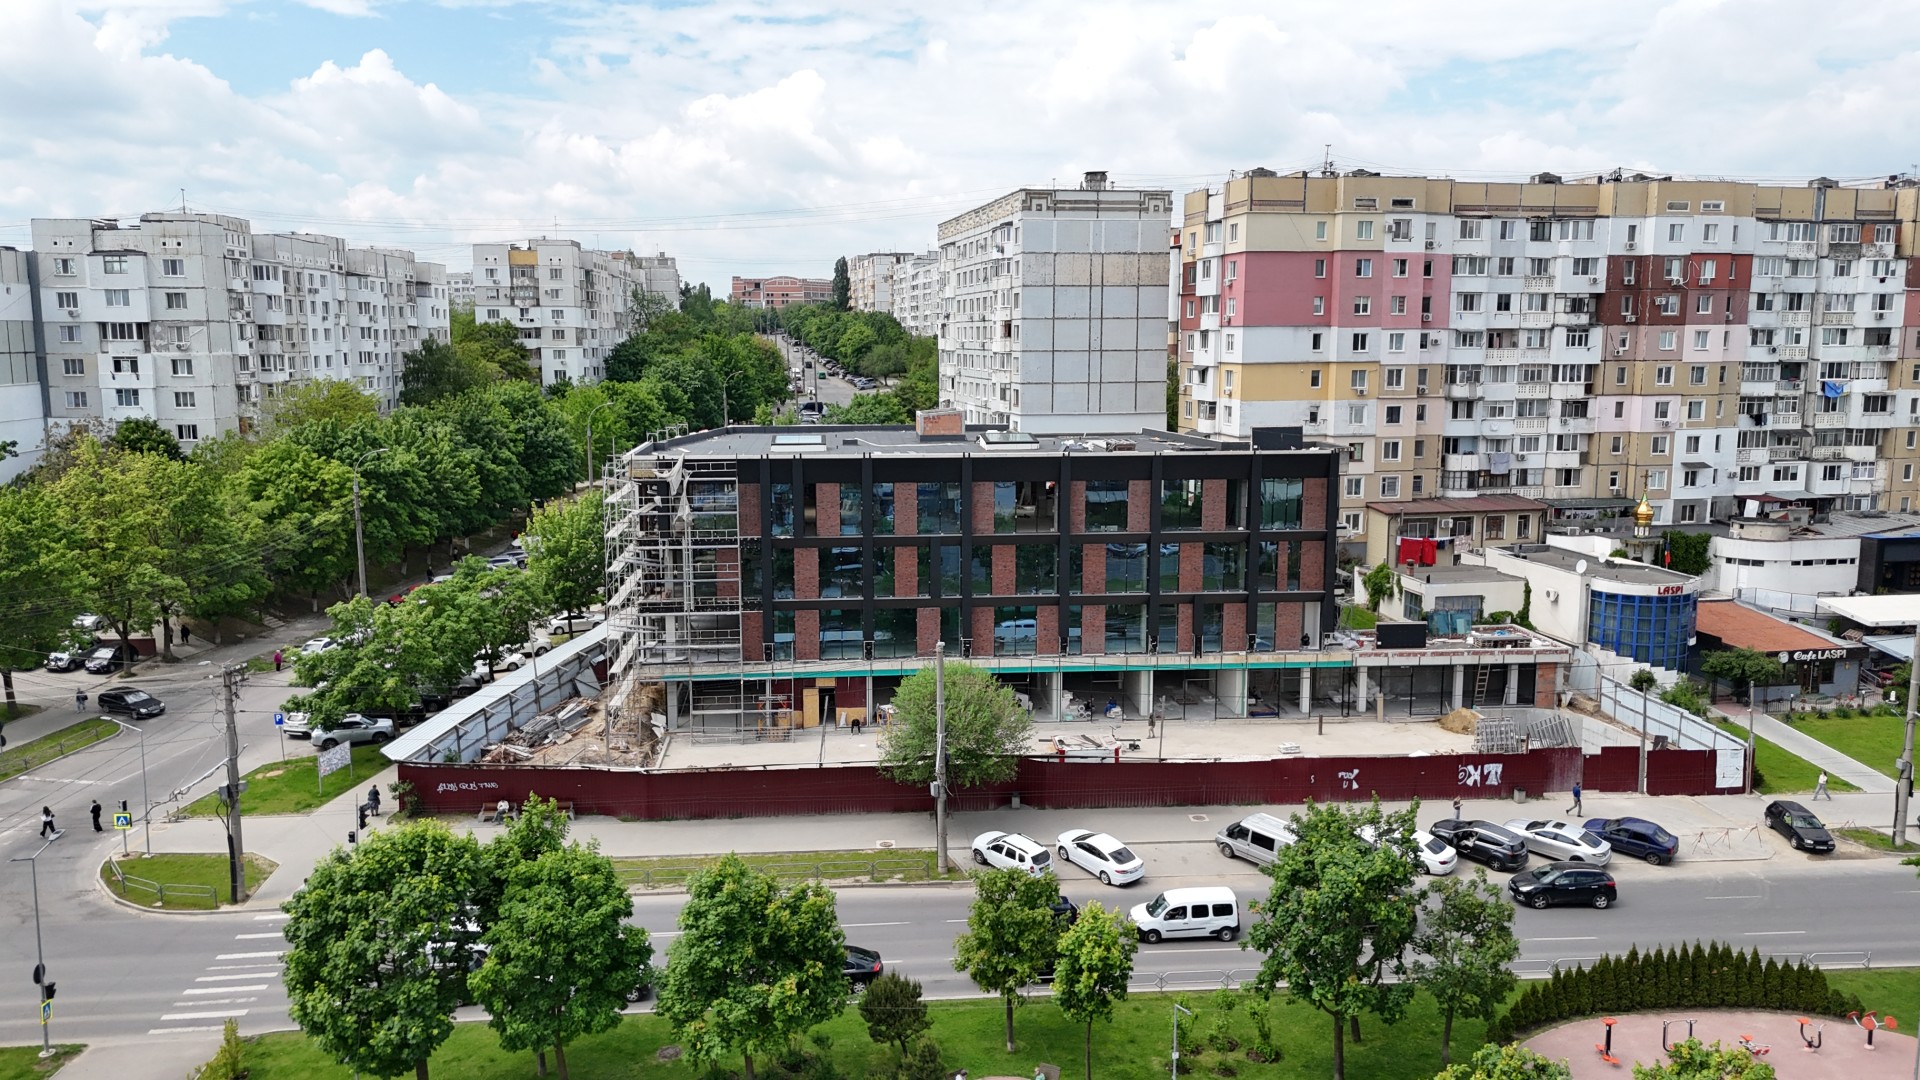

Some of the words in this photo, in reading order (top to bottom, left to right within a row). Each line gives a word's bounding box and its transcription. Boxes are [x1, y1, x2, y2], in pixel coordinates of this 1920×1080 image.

[1658, 586, 1684, 595] LASPI
[1793, 650, 1817, 662] Cafe
[1818, 649, 1847, 660] LASPI
